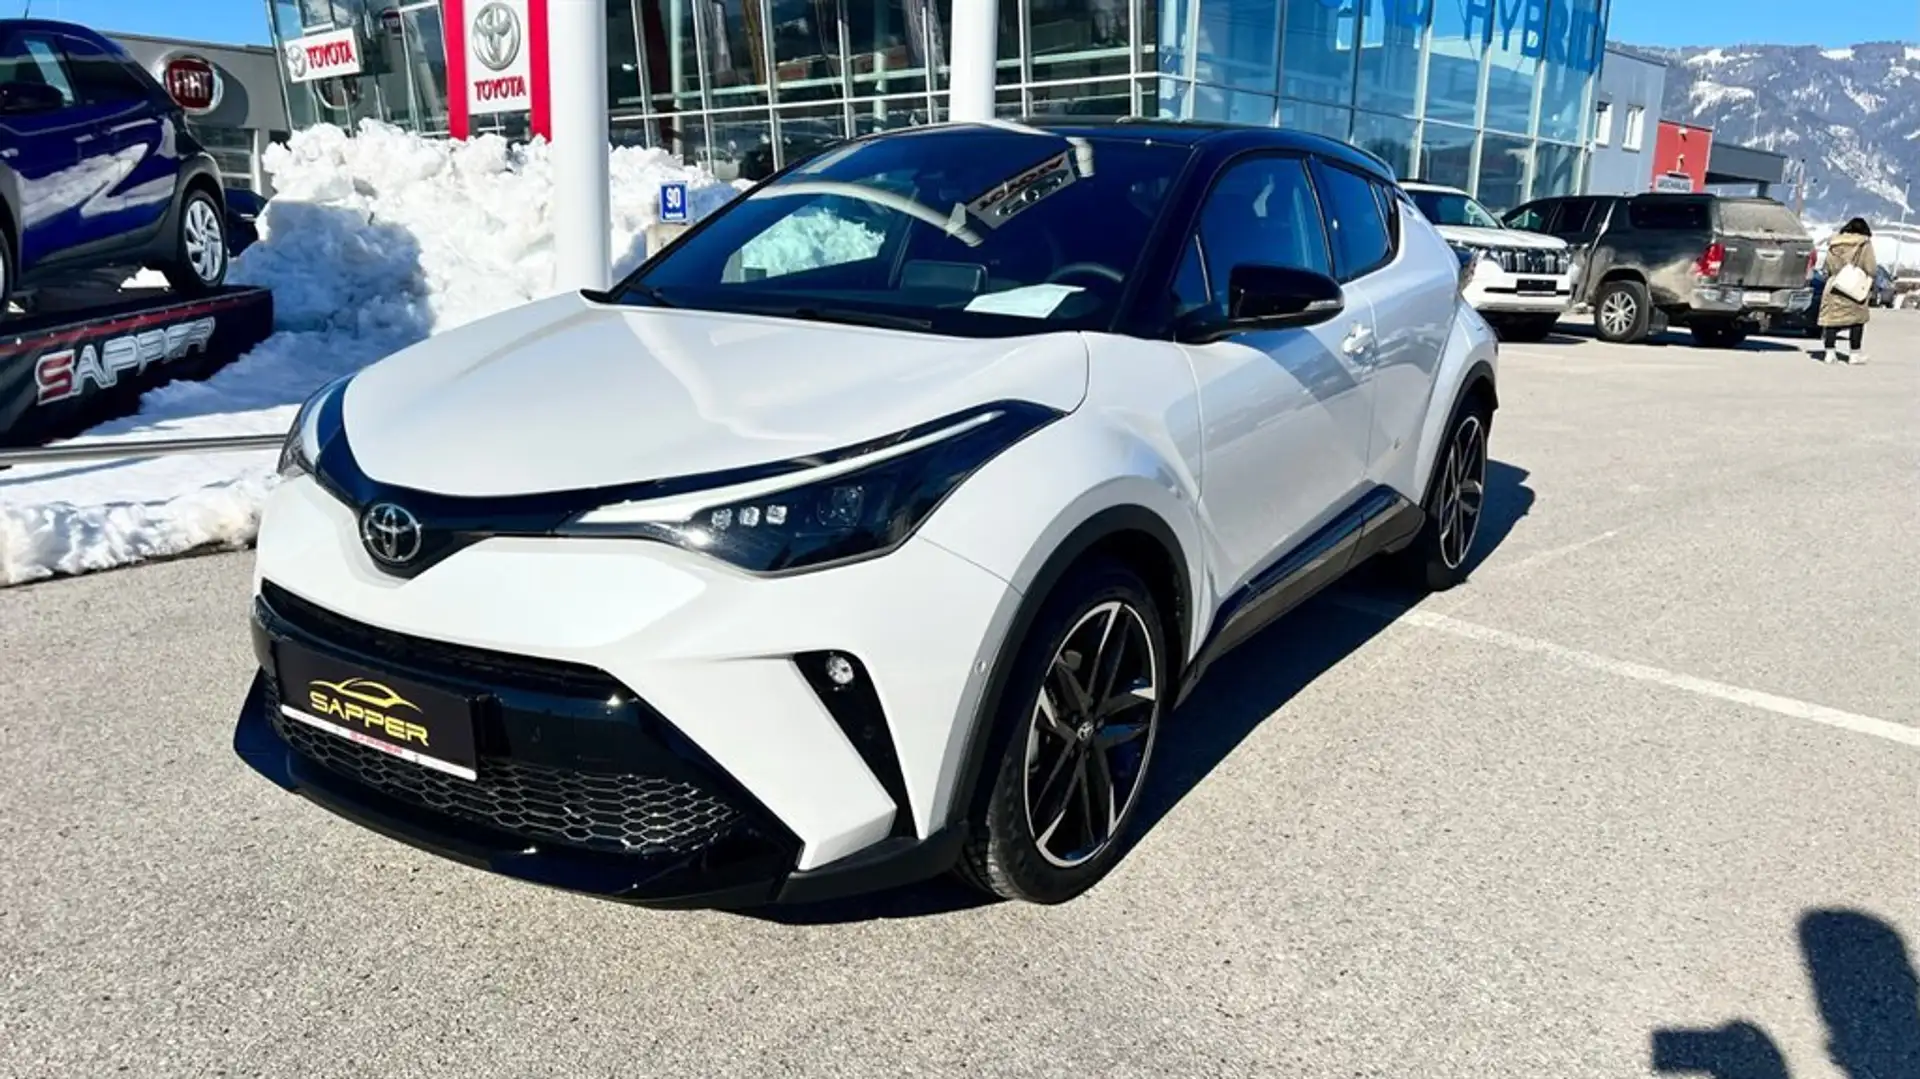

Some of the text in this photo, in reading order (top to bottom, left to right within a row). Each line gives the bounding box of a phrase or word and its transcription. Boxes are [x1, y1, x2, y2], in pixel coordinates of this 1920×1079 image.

[305, 40, 355, 69] TOYOTA
[171, 67, 211, 99] FIAT
[473, 75, 527, 101] TOYOTA
[666, 187, 681, 208] 90
[34, 316, 216, 406] SAPPER
[309, 690, 430, 747] SAPPER
